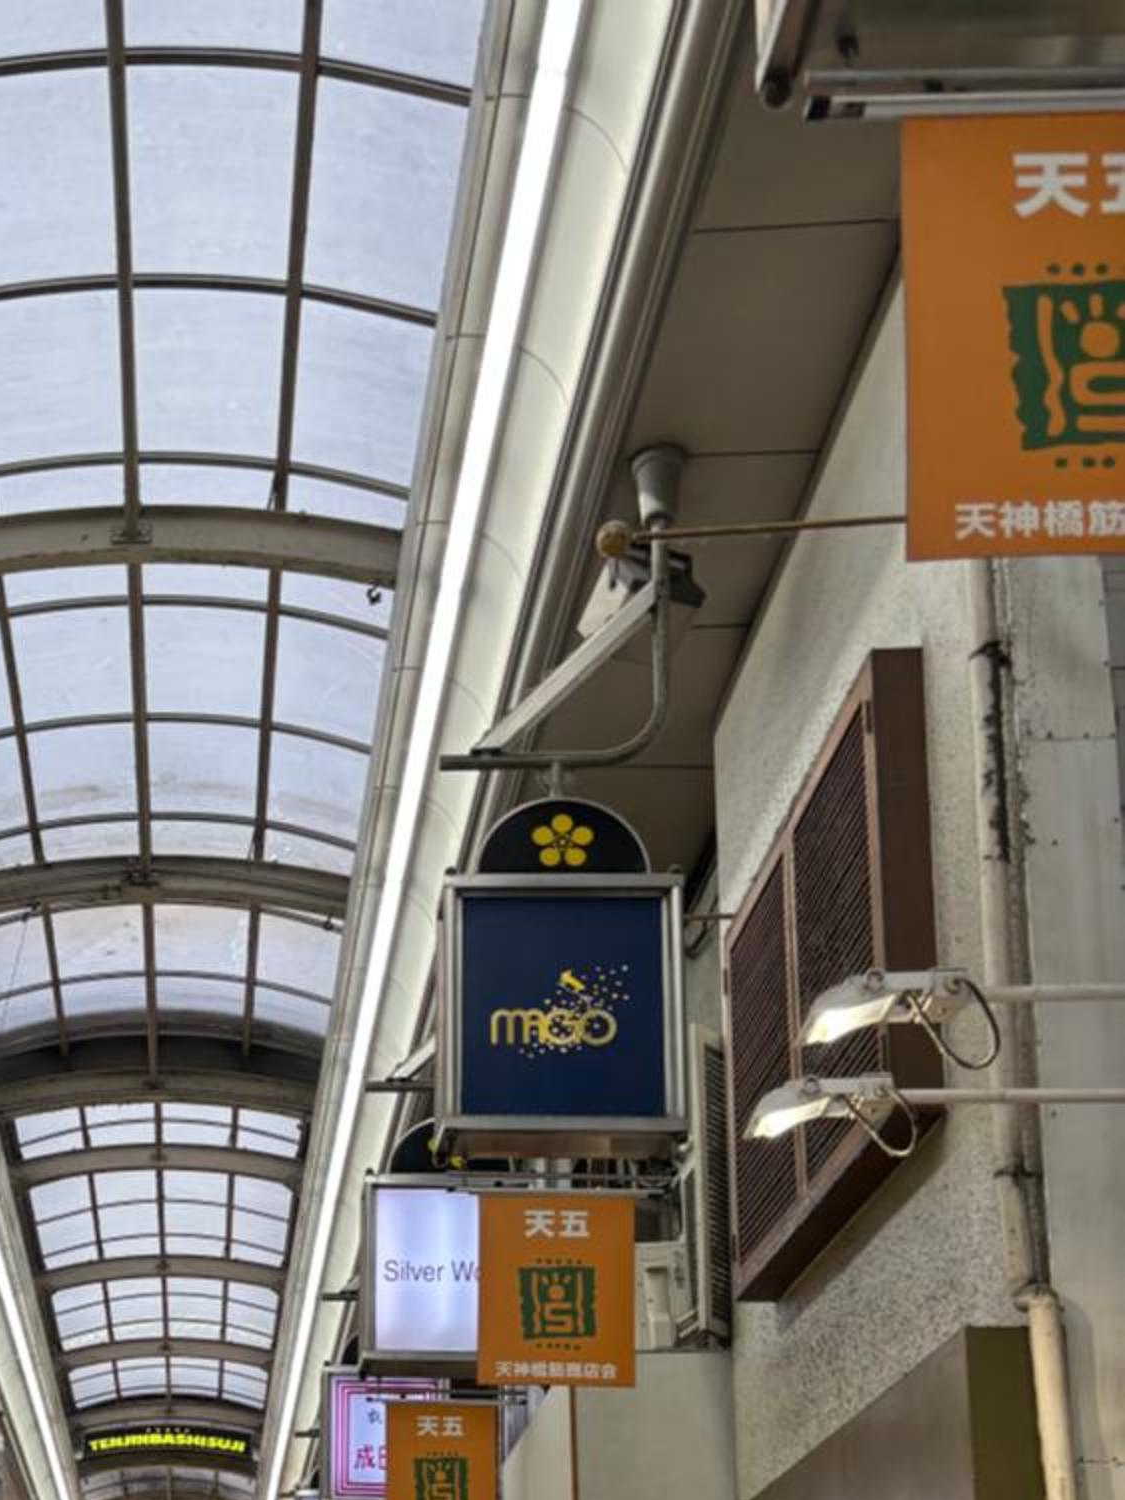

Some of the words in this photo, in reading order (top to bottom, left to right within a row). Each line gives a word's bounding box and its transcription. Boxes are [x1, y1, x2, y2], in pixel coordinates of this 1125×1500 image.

[523, 1208, 591, 1239] 天五
[383, 1259, 445, 1282] Silver
[415, 1414, 465, 1437] 天五
